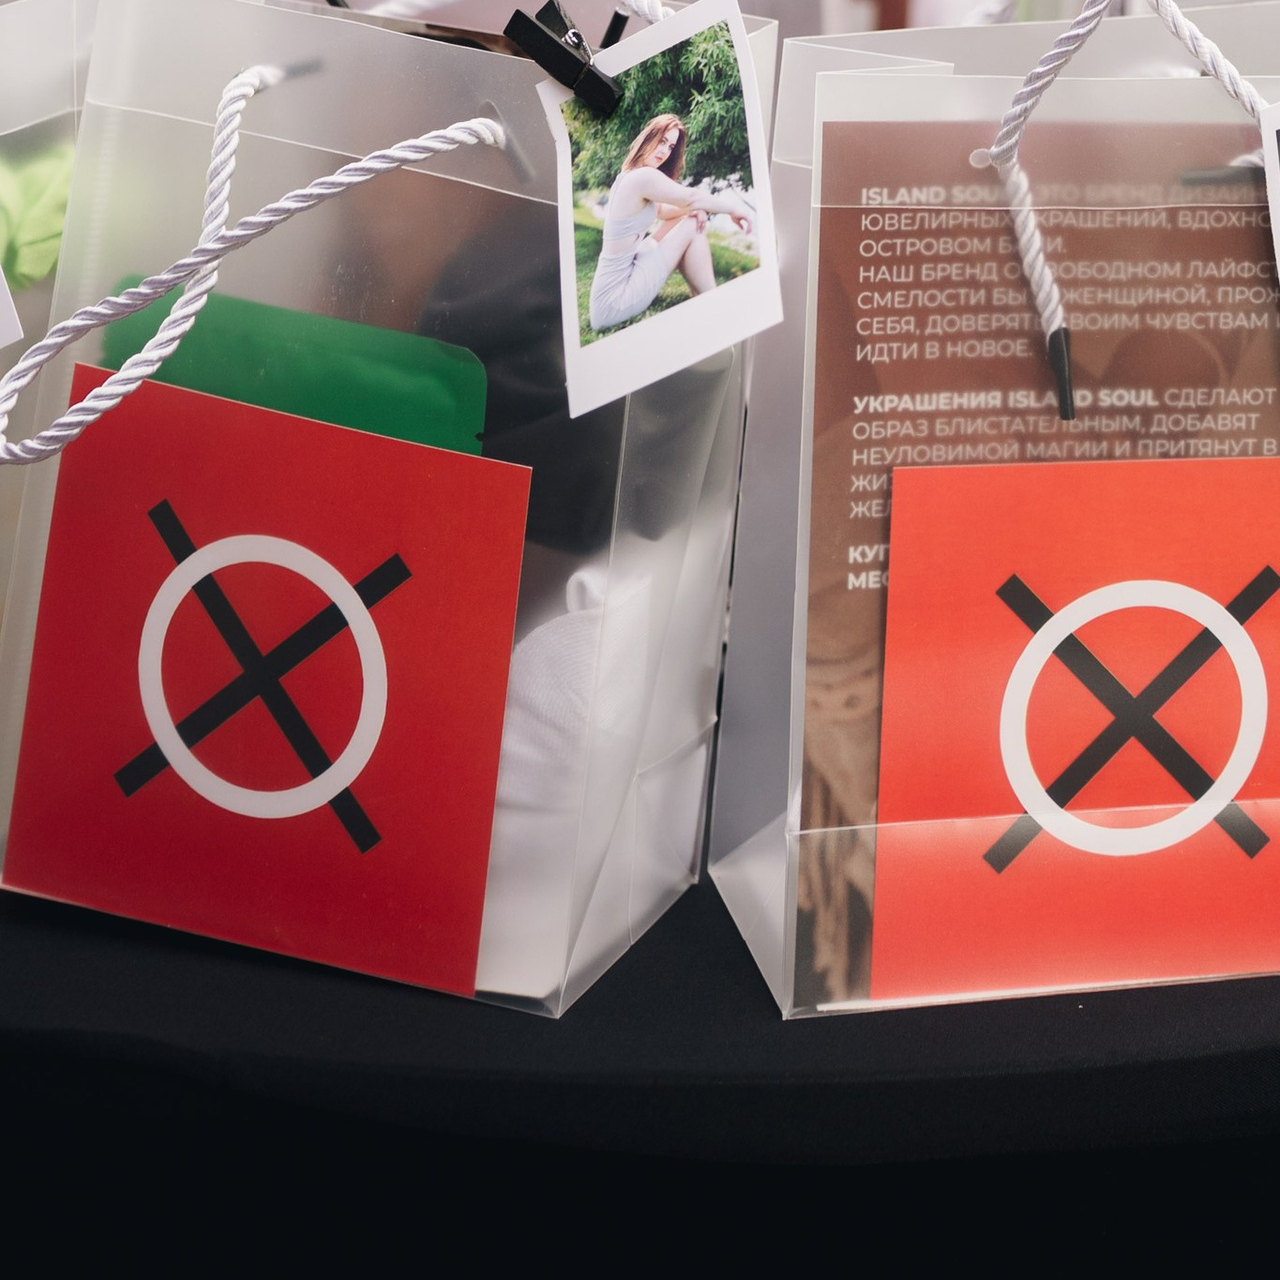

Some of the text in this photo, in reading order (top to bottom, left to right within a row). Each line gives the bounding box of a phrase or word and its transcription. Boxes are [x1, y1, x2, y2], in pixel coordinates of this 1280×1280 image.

[861, 187, 946, 206] ISLAND
[951, 186, 1012, 204] SOU
[861, 211, 1012, 231] ЮВЕЛИРНЫХ
[1033, 208, 1171, 229] КРАШЕНИЙ,
[859, 236, 1067, 257] ОСТРОВОМ БИ.
[859, 265, 914, 283] НАШ
[920, 263, 999, 282] БРЕНД
[1004, 262, 1022, 279] О
[857, 290, 986, 310] СМЕЛОСТИ
[1061, 284, 1212, 305] ЖЕНЩИНОЙ,
[856, 317, 921, 336] СЕБЯ,
[1145, 311, 1269, 330] ЧУВСТВАМ
[856, 338, 1033, 364] ИДТИ В НОВОЕ.
[853, 391, 1002, 414] УКРАШЕНИЯ
[1007, 388, 1093, 408] ISLAD
[1098, 388, 1159, 407] SOUL
[1164, 386, 1277, 406] СДЕЛАЮТ
[852, 413, 1261, 440] ОБРАЗ БЛИСТАТЕЛЬНЫМ, ДОБАВЯТ
[852, 438, 1019, 466] НЕУЛОВИМОЙ
[1026, 438, 1108, 459] МАГИИ
[1114, 438, 1132, 457] И
[1137, 436, 1258, 457] ПРИТЯНУТ
[1263, 437, 1279, 455] В
[851, 473, 893, 492] ЖИ
